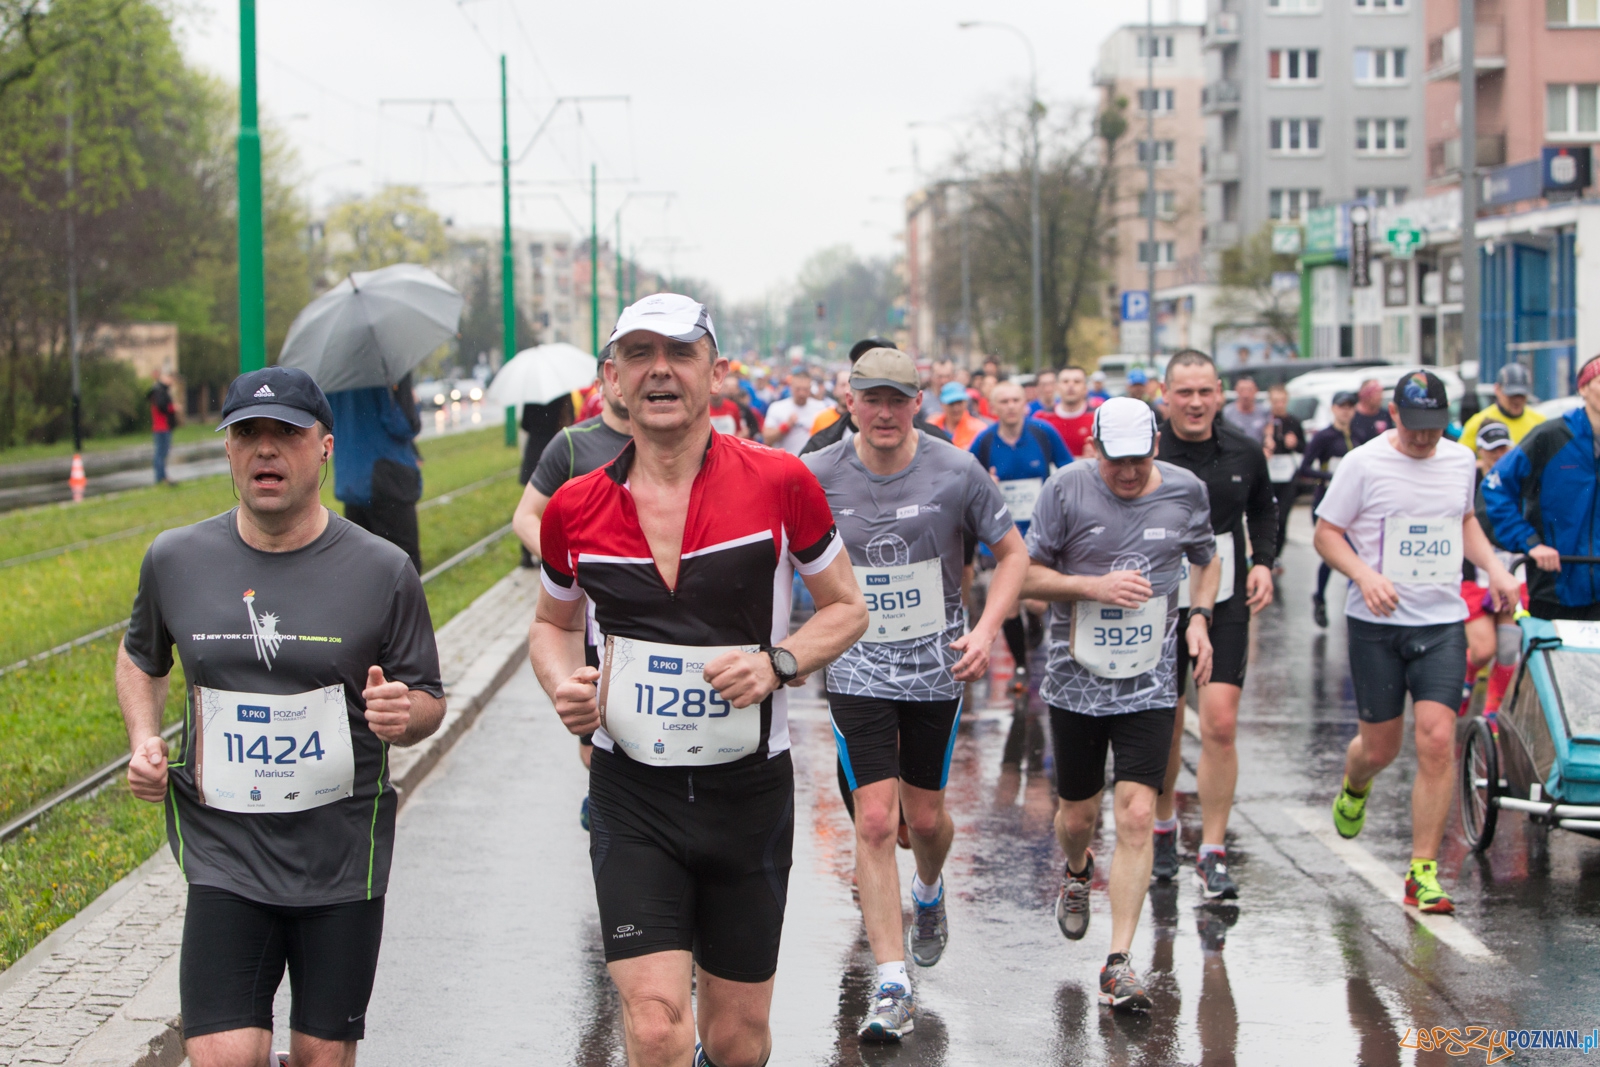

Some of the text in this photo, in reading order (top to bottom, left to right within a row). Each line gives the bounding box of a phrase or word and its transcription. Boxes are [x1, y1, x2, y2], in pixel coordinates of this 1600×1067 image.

[1127, 293, 1147, 317] P
[1399, 539, 1451, 557] 8240
[863, 588, 921, 612] 3619
[882, 612, 906, 620] Marcin
[1093, 624, 1152, 646] 3929
[686, 662, 705, 670] POZ
[634, 682, 731, 718] 11285
[662, 721, 698, 731] Leszek
[223, 731, 325, 764] 11424
[687, 746, 704, 754] 4F
[254, 768, 295, 779] Mariusz
[284, 791, 300, 800] 4F
